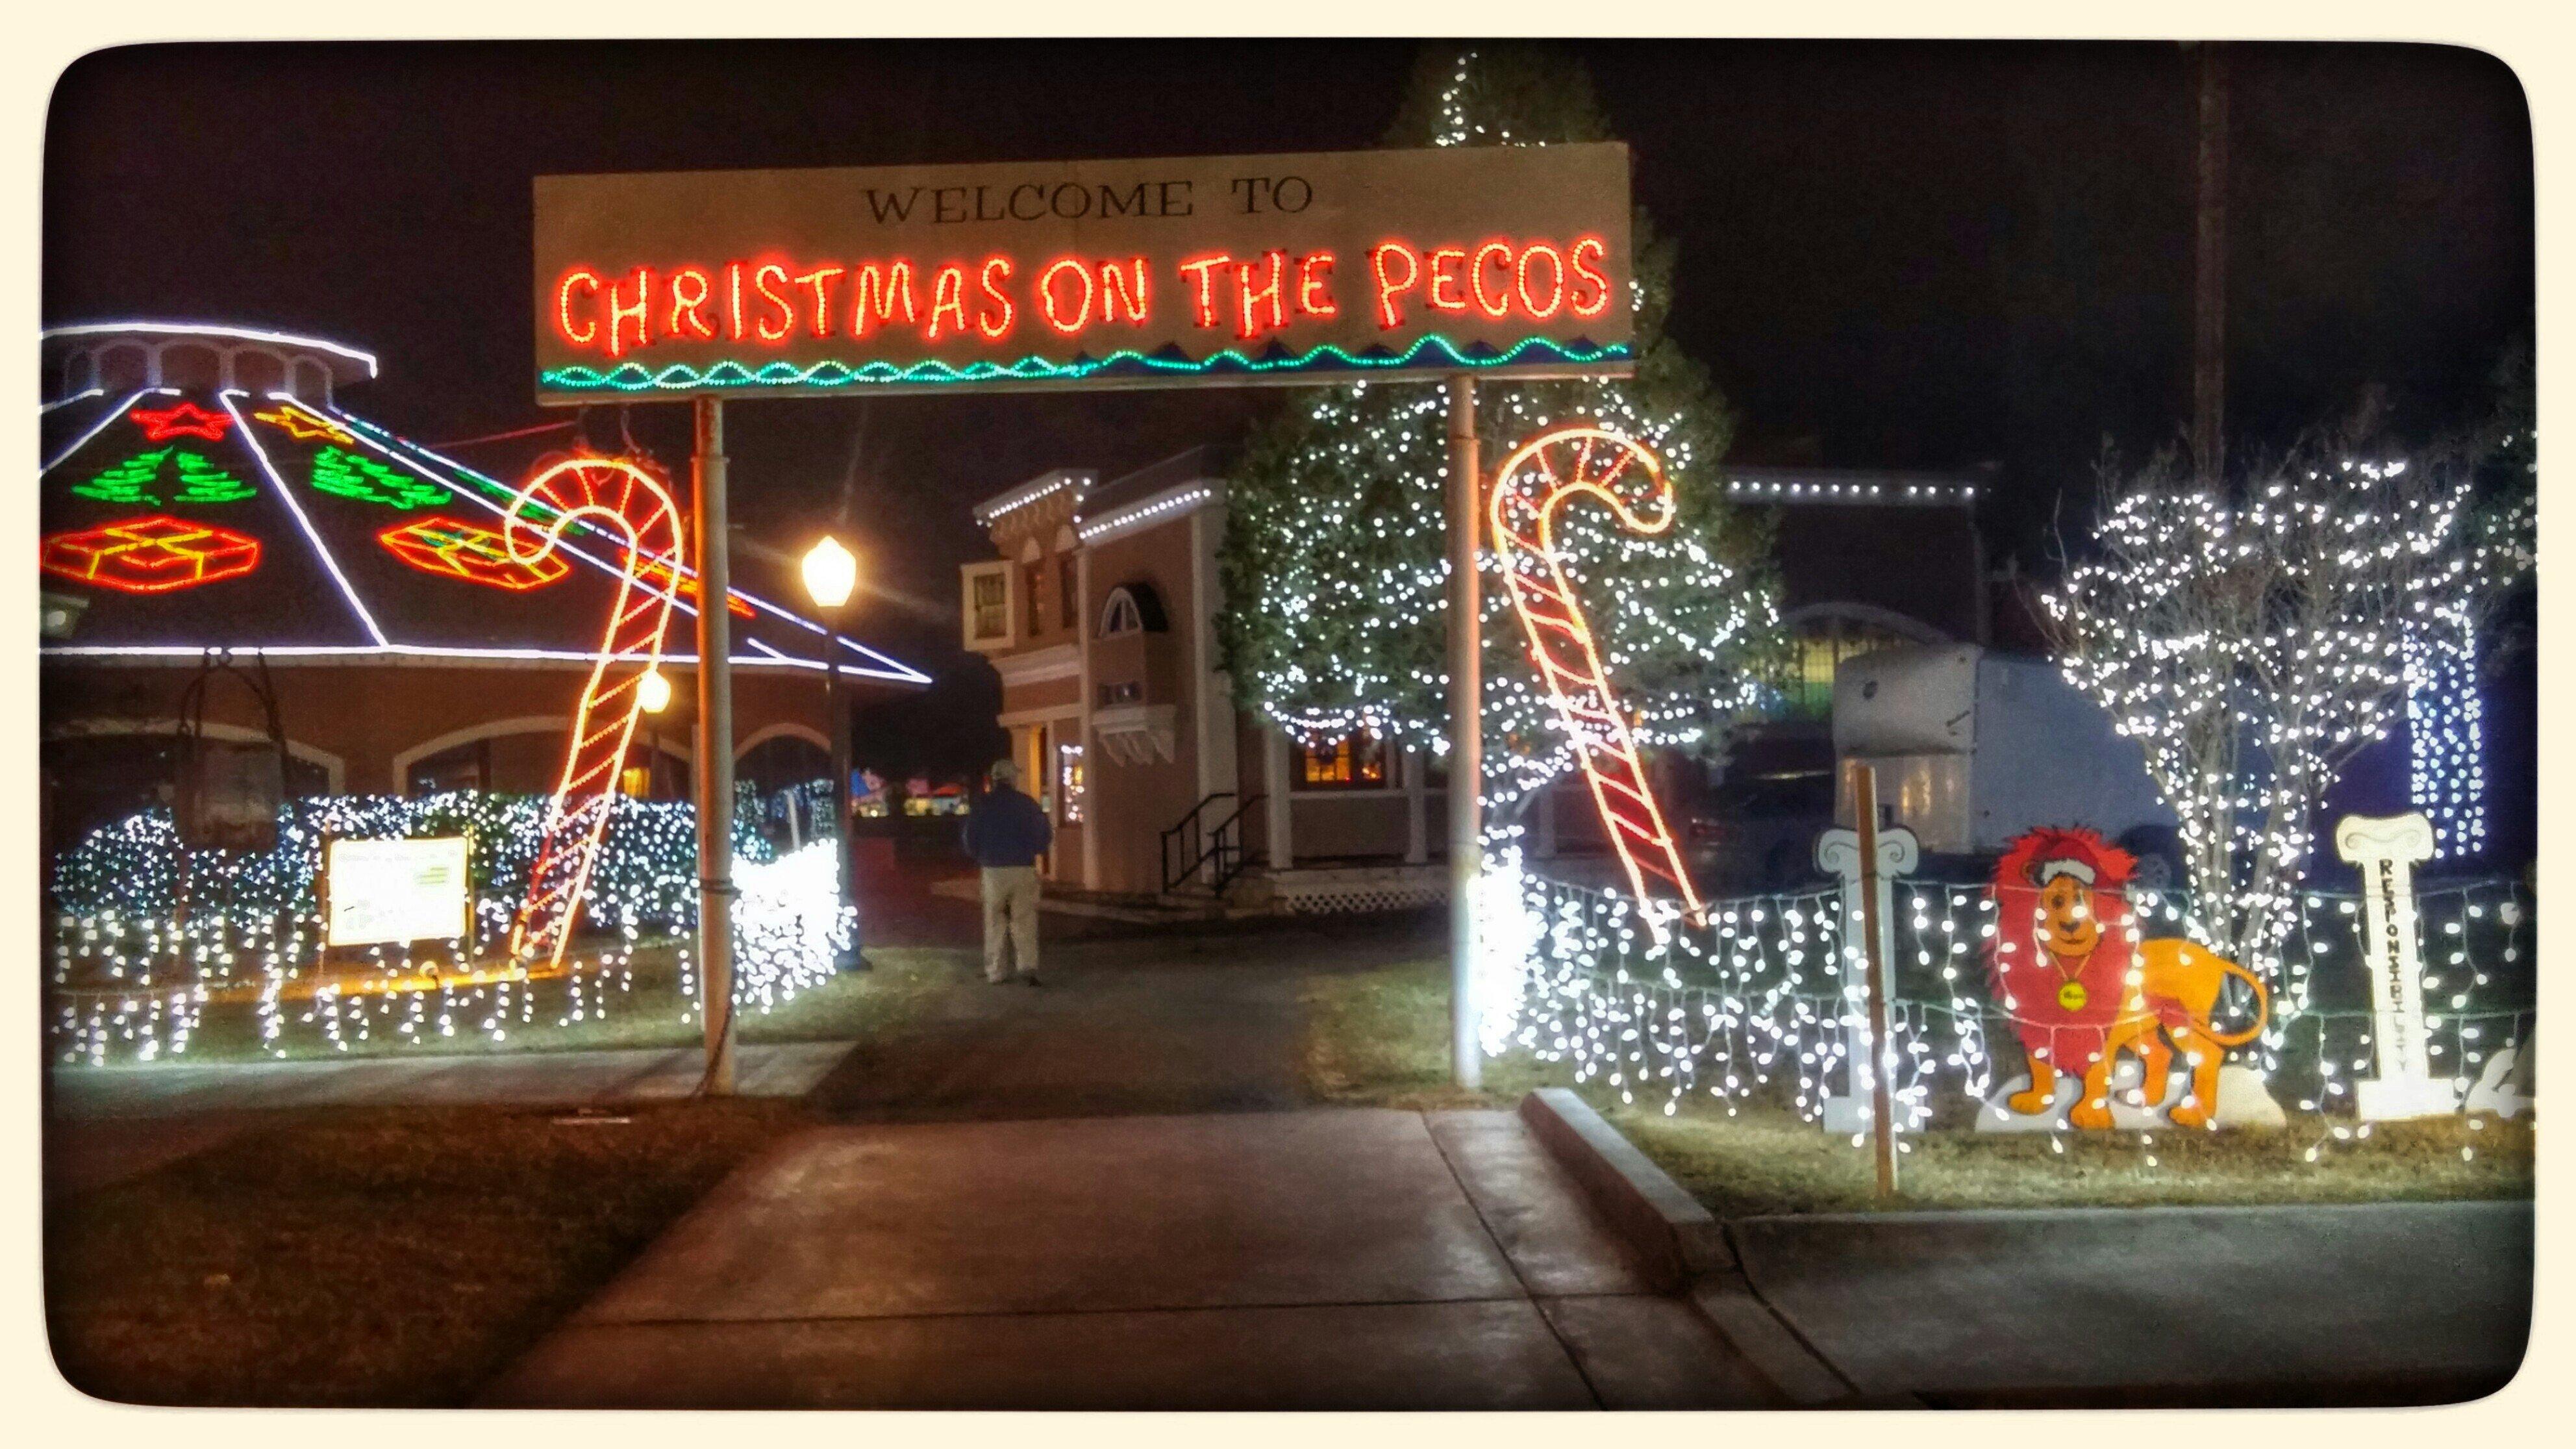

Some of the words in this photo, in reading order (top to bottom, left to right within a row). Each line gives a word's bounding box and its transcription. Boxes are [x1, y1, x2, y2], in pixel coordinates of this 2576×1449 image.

[864, 180, 1195, 225] WELCOME
[1231, 175, 1313, 214] TO
[558, 257, 1013, 357] CHRISTMAS
[1040, 258, 1148, 333] ON
[1180, 249, 1336, 339] THE
[1371, 238, 1609, 330] PECOS
